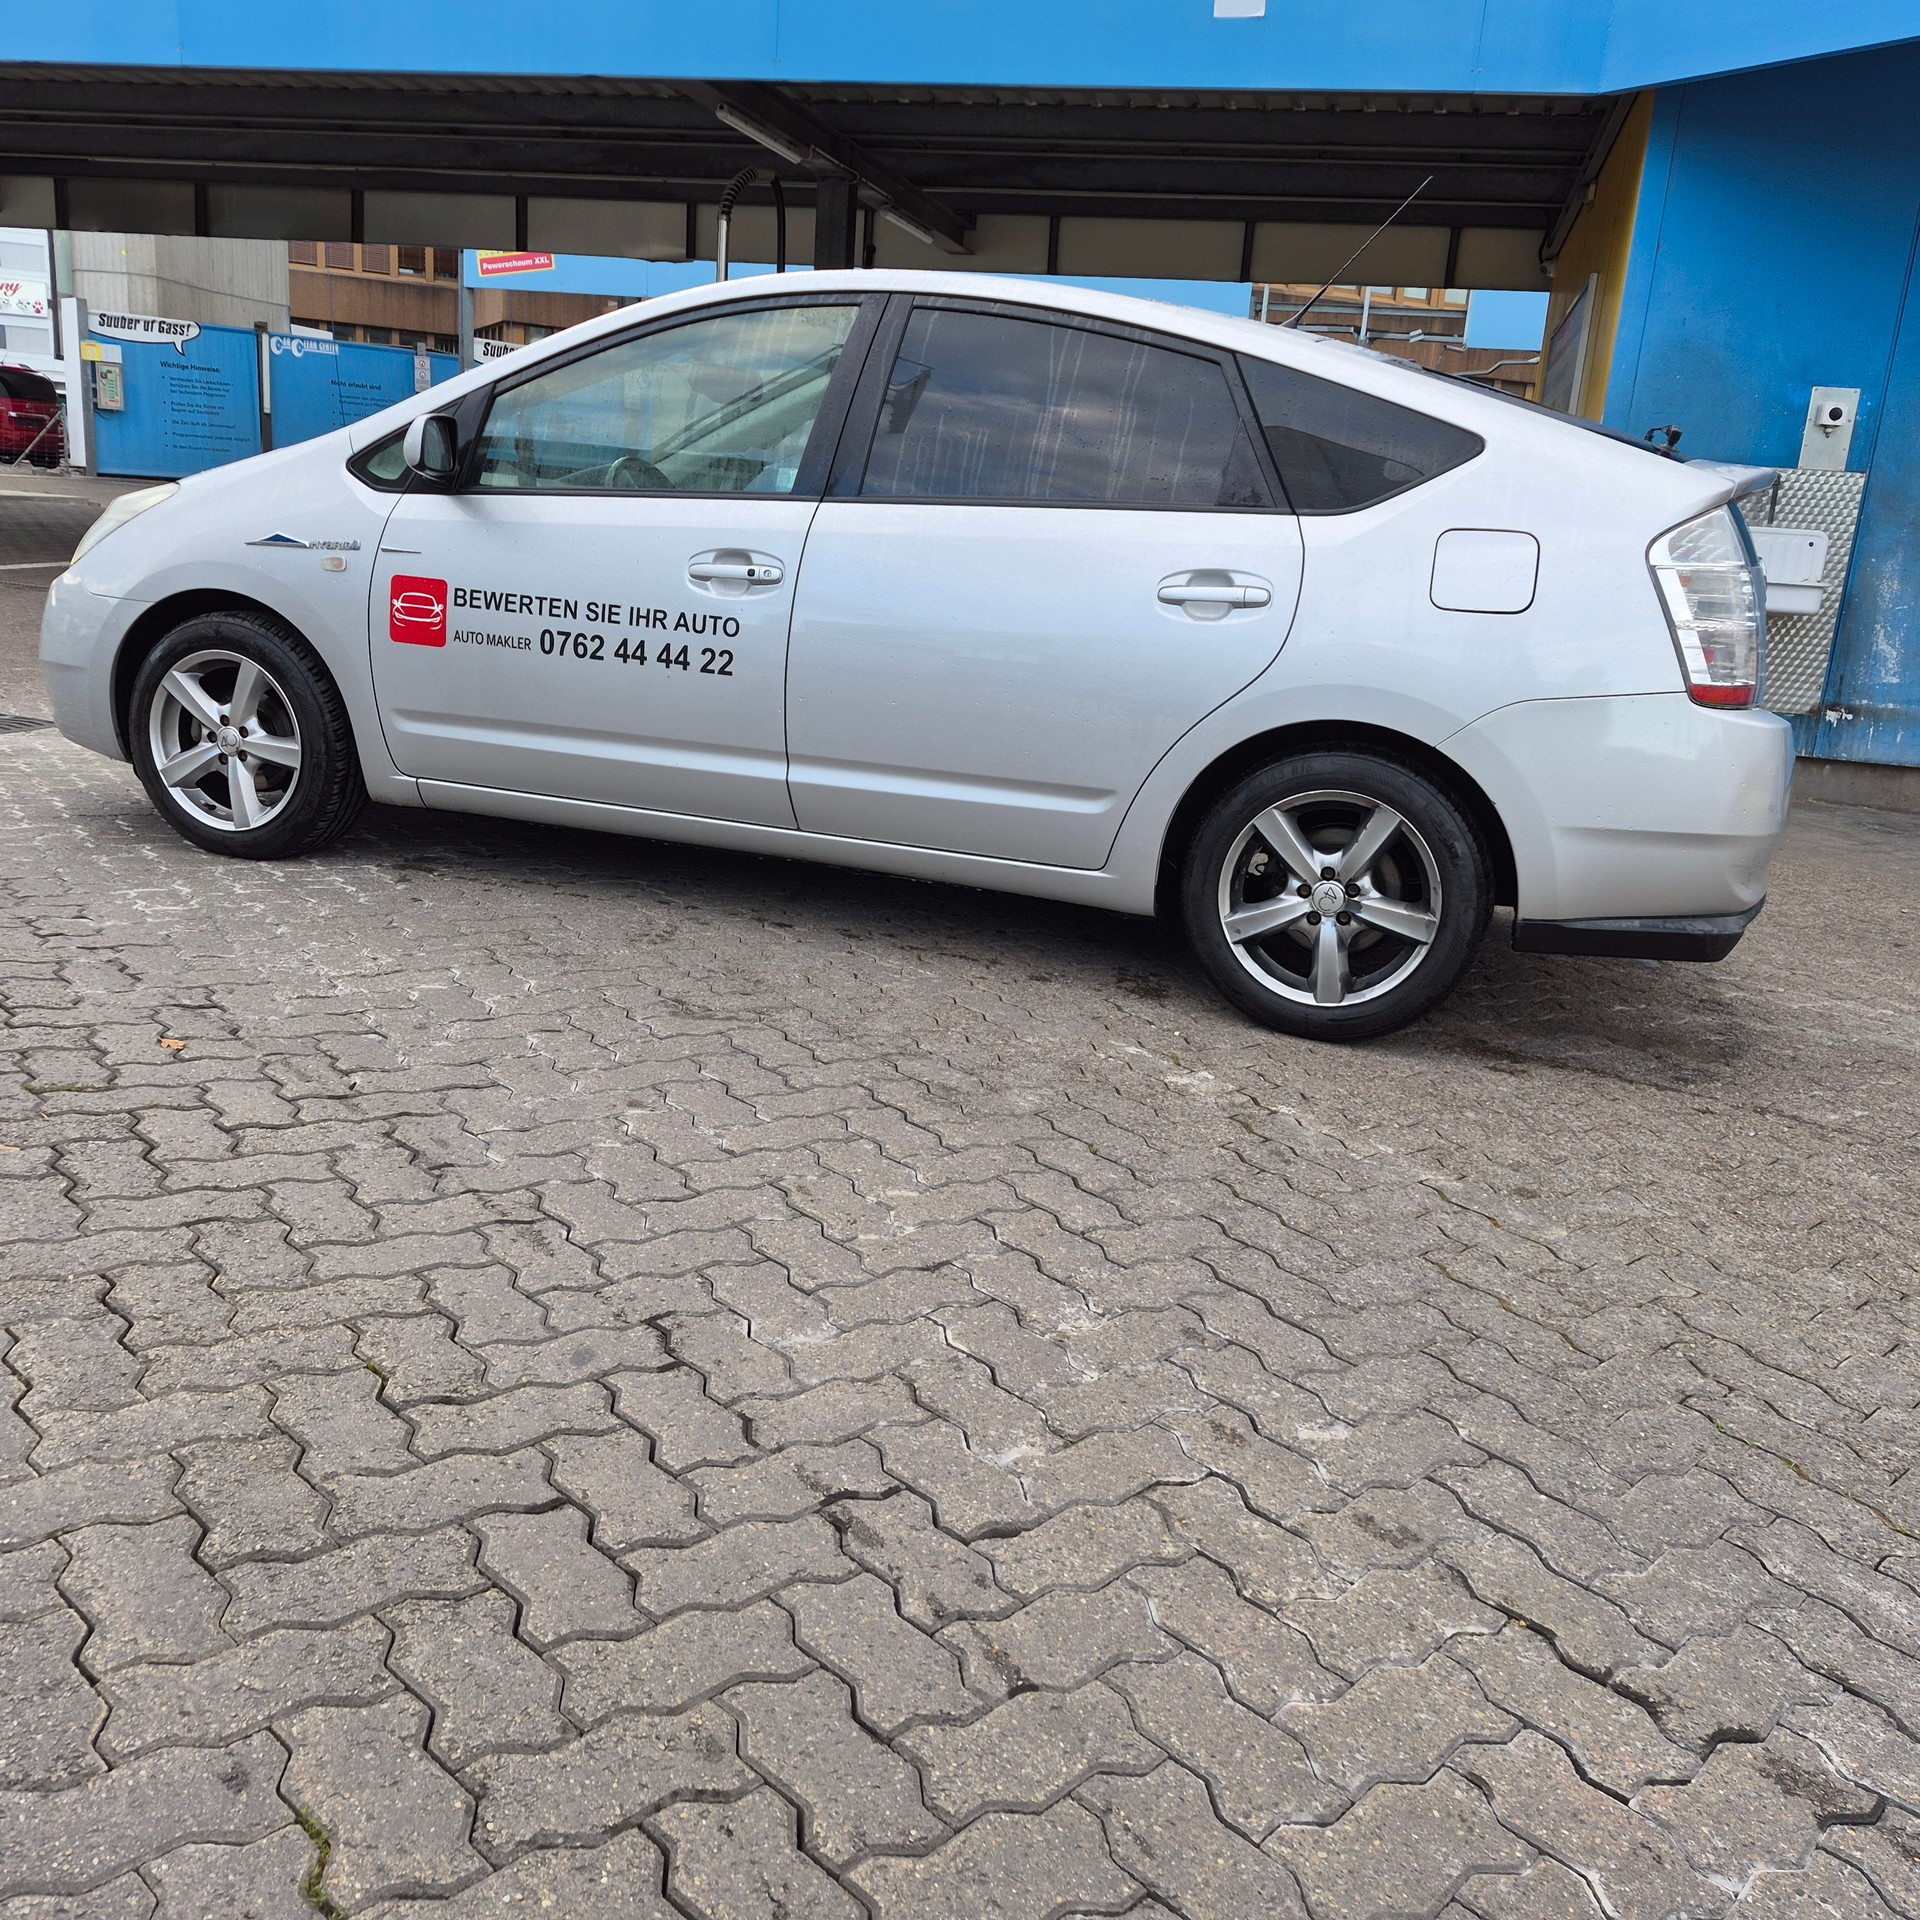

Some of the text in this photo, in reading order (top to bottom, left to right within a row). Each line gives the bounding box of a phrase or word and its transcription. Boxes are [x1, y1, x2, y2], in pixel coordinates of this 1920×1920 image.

[482, 256, 550, 270] Powerschaum XXL
[99, 313, 192, 337] Suuber uf Gass!
[483, 342, 518, 358] Suub
[160, 361, 221, 373] Wichtige Hinweise:
[330, 379, 347, 387] Nicht
[348, 381, 368, 389] erlaubt
[453, 587, 740, 638] BEWERTEN SIE IHR AUTO
[453, 628, 734, 676] AUTO MAKLER 0762 44 44 22
